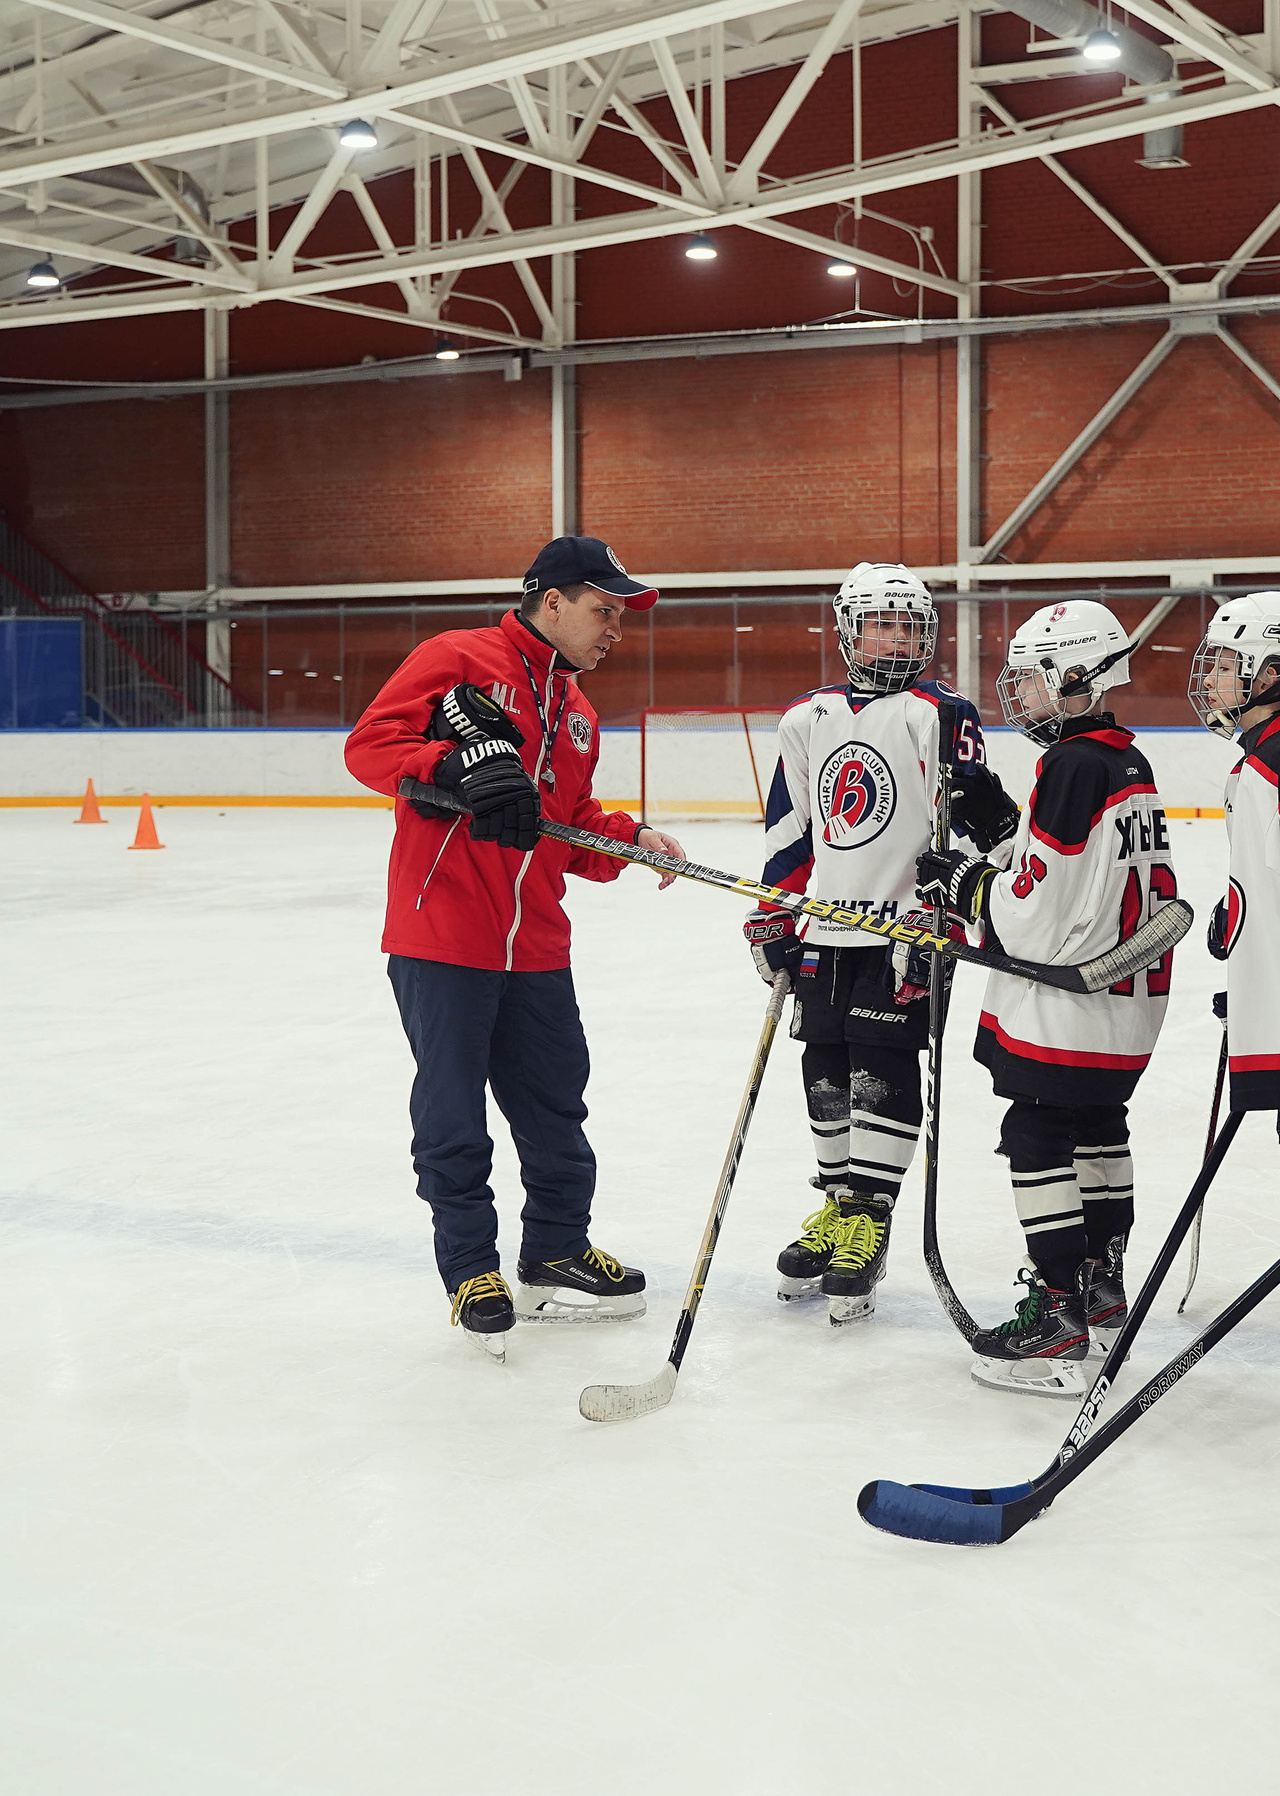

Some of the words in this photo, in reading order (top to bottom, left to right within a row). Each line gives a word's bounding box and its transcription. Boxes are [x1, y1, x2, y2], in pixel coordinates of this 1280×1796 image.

[884, 591, 916, 599] BAUER
[1059, 635, 1097, 648] BAUER
[861, 751, 885, 777] CLUB
[872, 782, 891, 824] VIKHR
[1011, 852, 1048, 900] 6
[743, 922, 785, 940] UER
[802, 898, 951, 952] BAUER
[849, 1006, 909, 1024] BAUER
[568, 1266, 599, 1284] BAUER
[1137, 1341, 1205, 1413] NORDWAY
